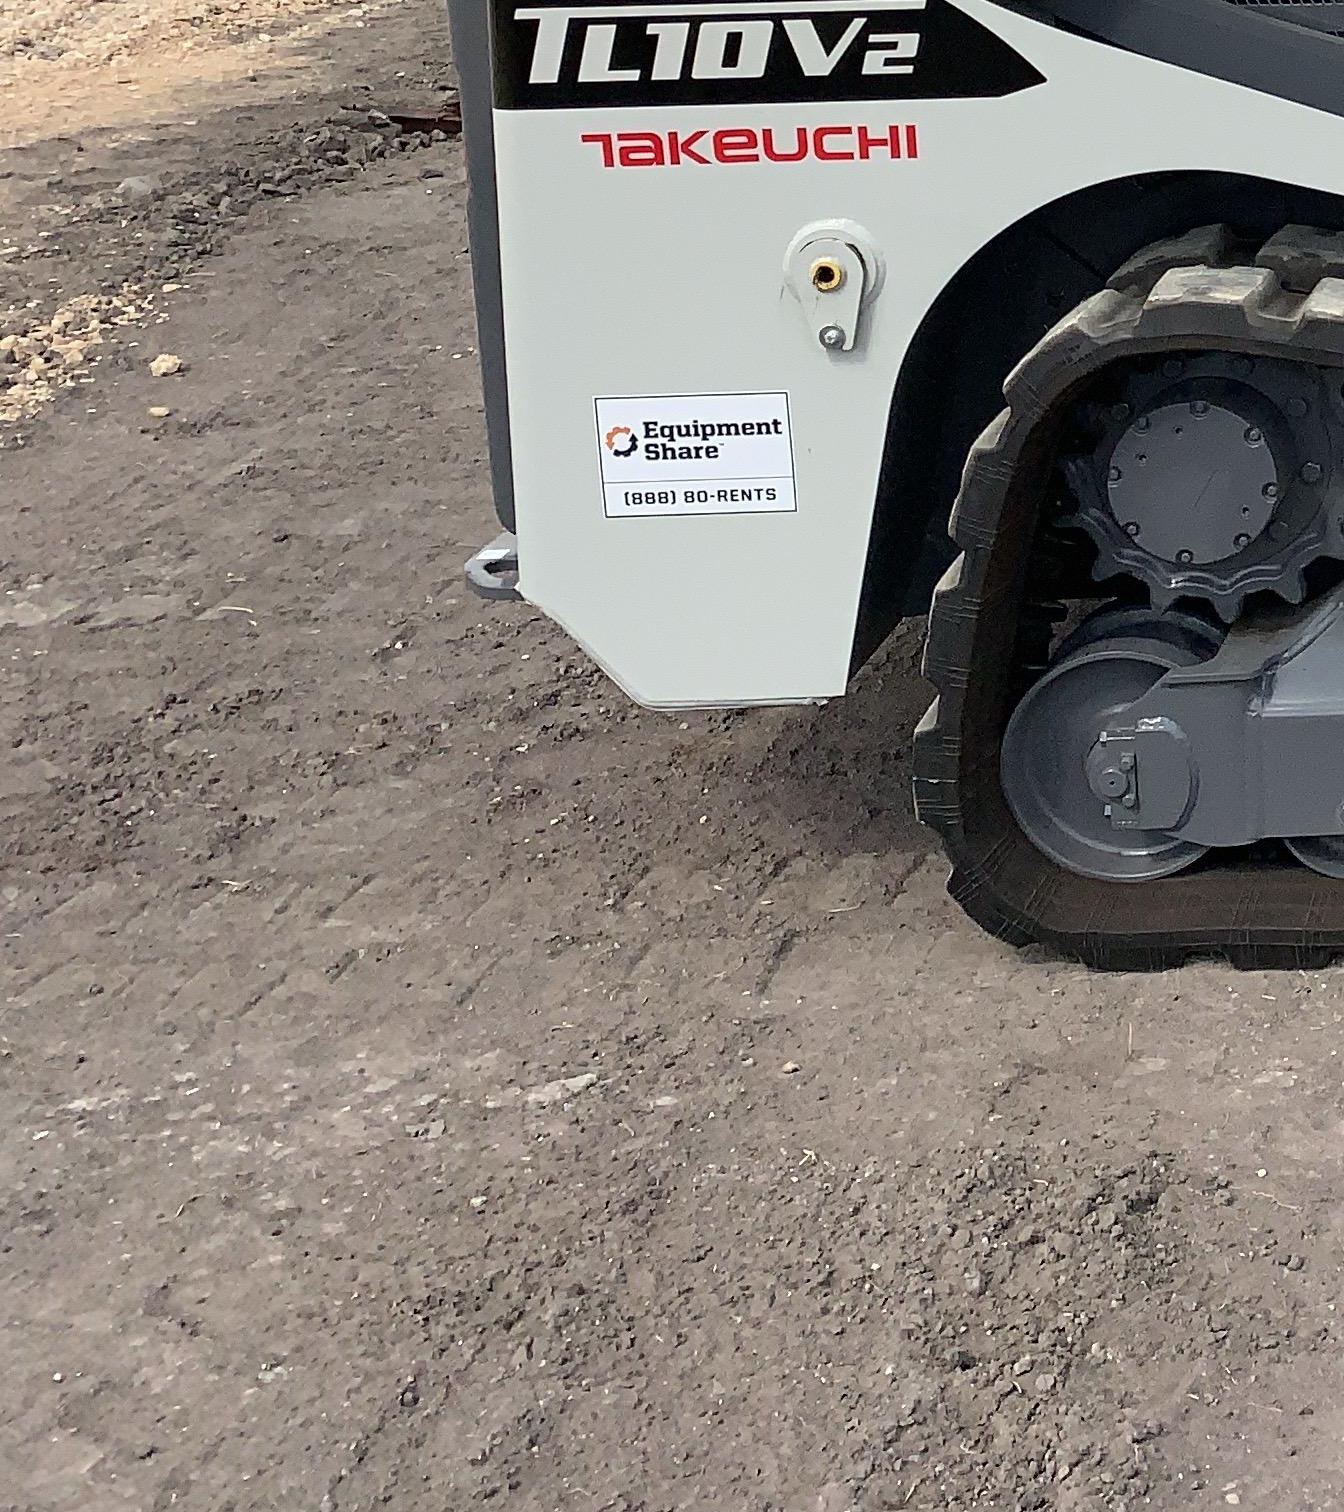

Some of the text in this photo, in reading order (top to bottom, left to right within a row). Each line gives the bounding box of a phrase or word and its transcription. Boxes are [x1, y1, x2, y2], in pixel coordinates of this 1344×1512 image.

[642, 418, 783, 441] Equipment
[644, 443, 719, 461] Share
[624, 488, 777, 507] (888) 80-RENTS
